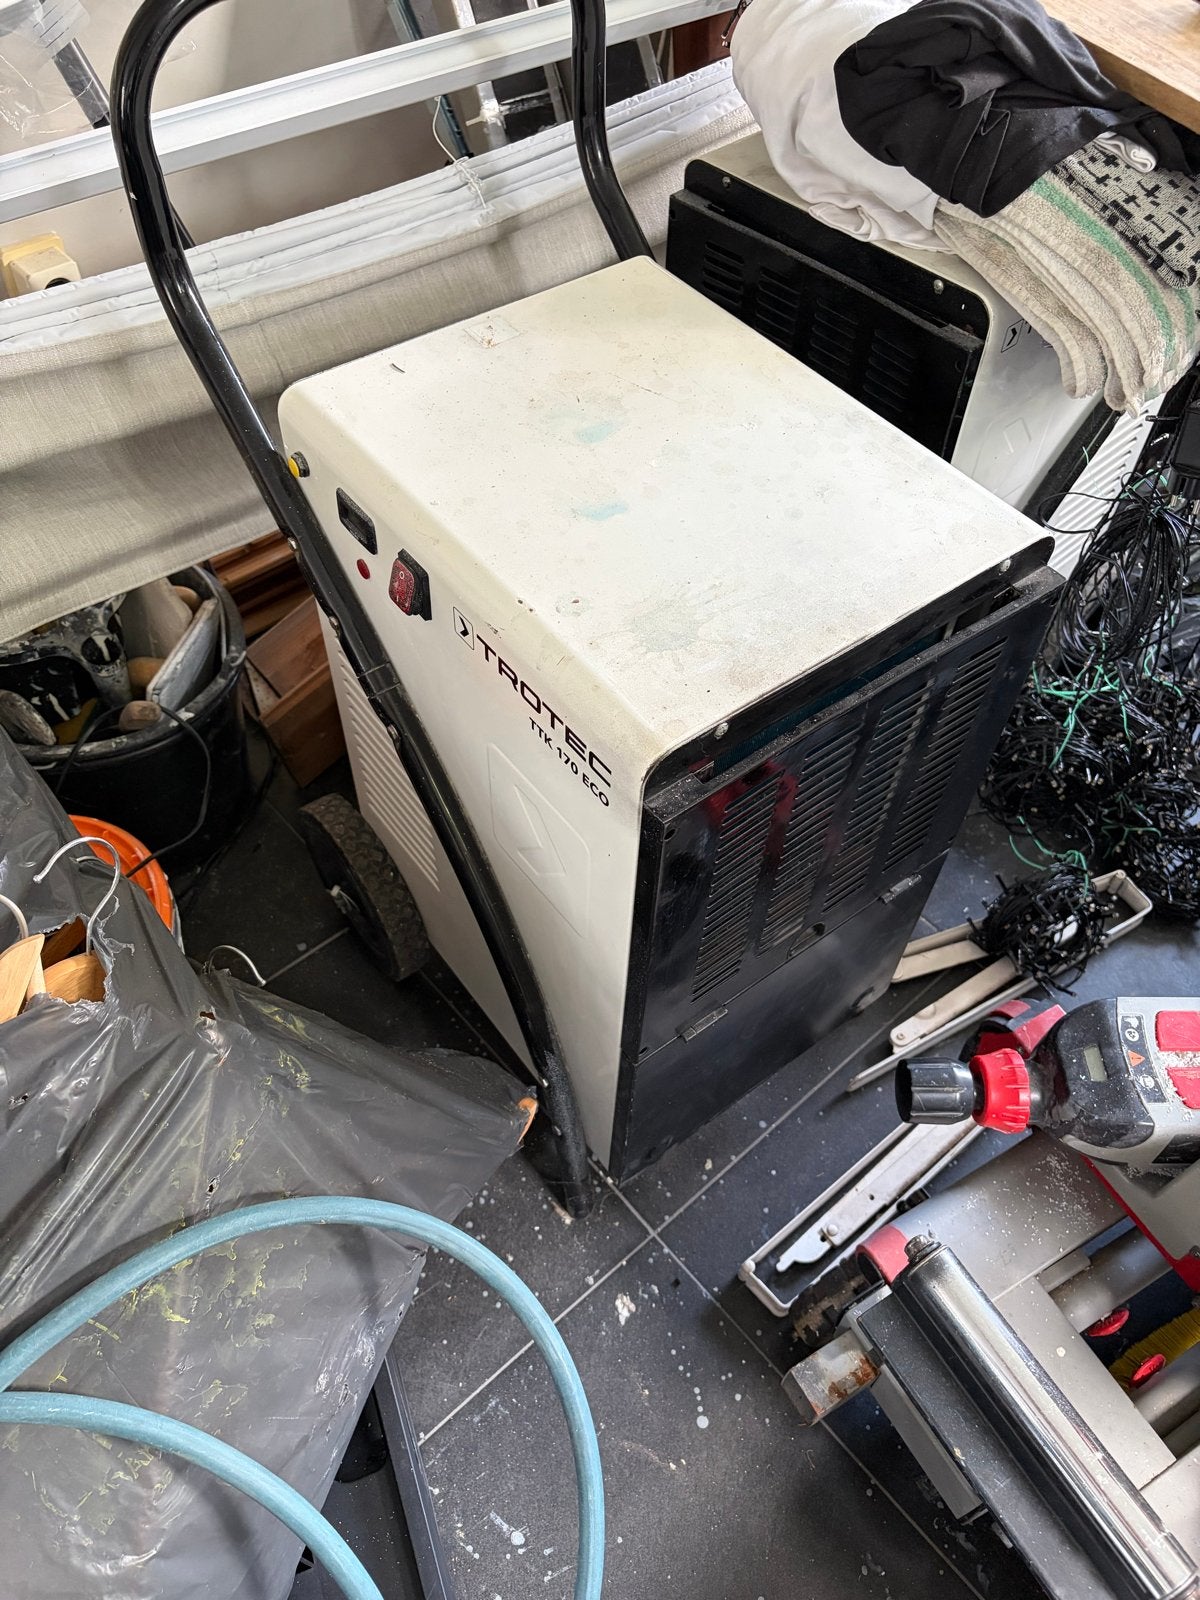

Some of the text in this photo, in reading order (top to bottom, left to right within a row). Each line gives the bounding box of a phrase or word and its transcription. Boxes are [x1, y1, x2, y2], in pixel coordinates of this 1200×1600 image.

[476, 633, 612, 788] TROTEC
[528, 716, 610, 807] TTK 170 ECO
